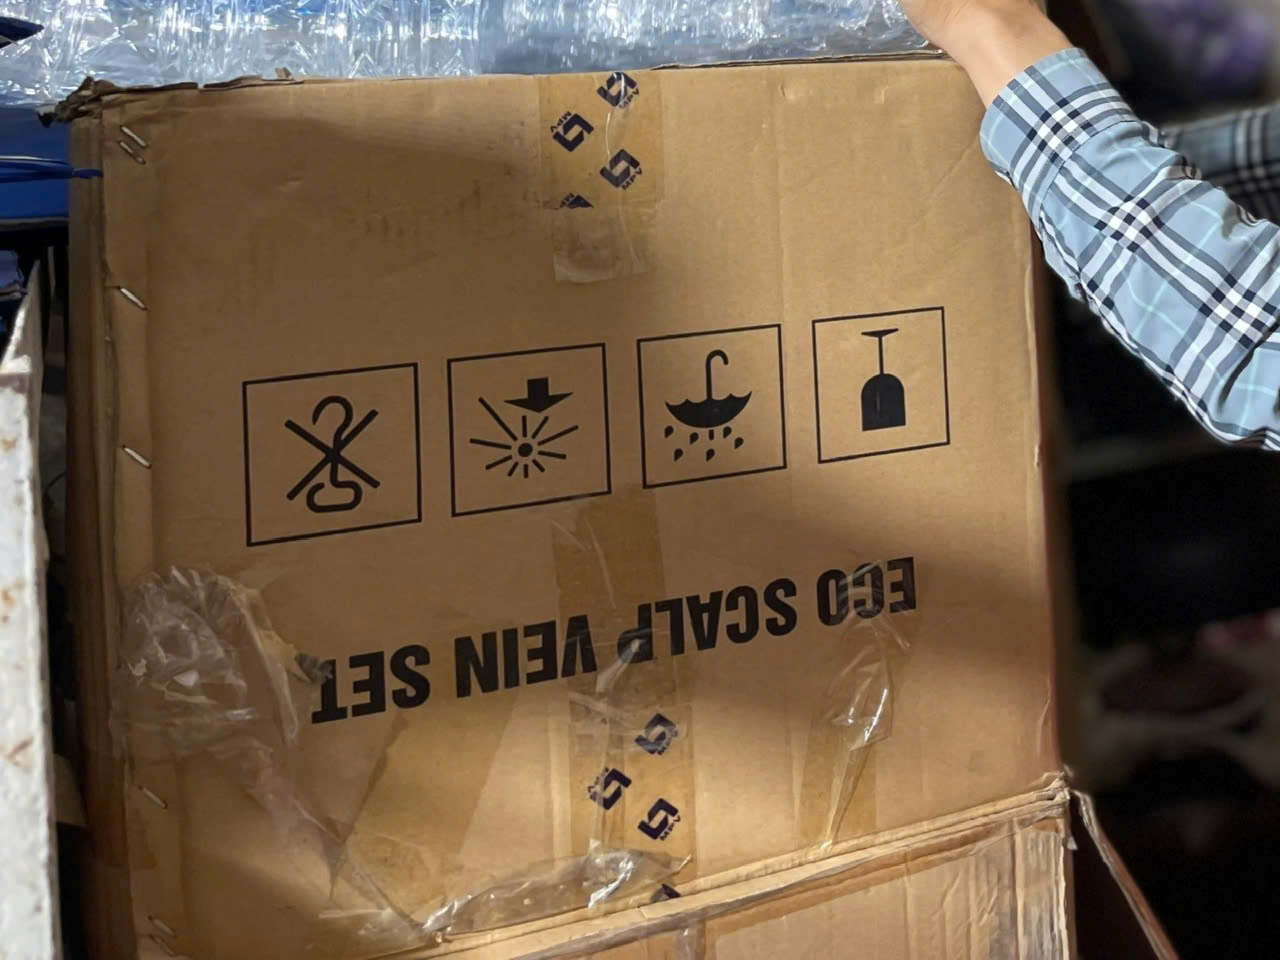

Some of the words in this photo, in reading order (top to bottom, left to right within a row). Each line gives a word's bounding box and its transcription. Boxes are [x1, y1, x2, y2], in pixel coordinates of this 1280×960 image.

[616, 578, 798, 664] SCALP
[816, 557, 917, 626] ECO
[311, 644, 431, 724] SET
[454, 614, 597, 698] VEIN
